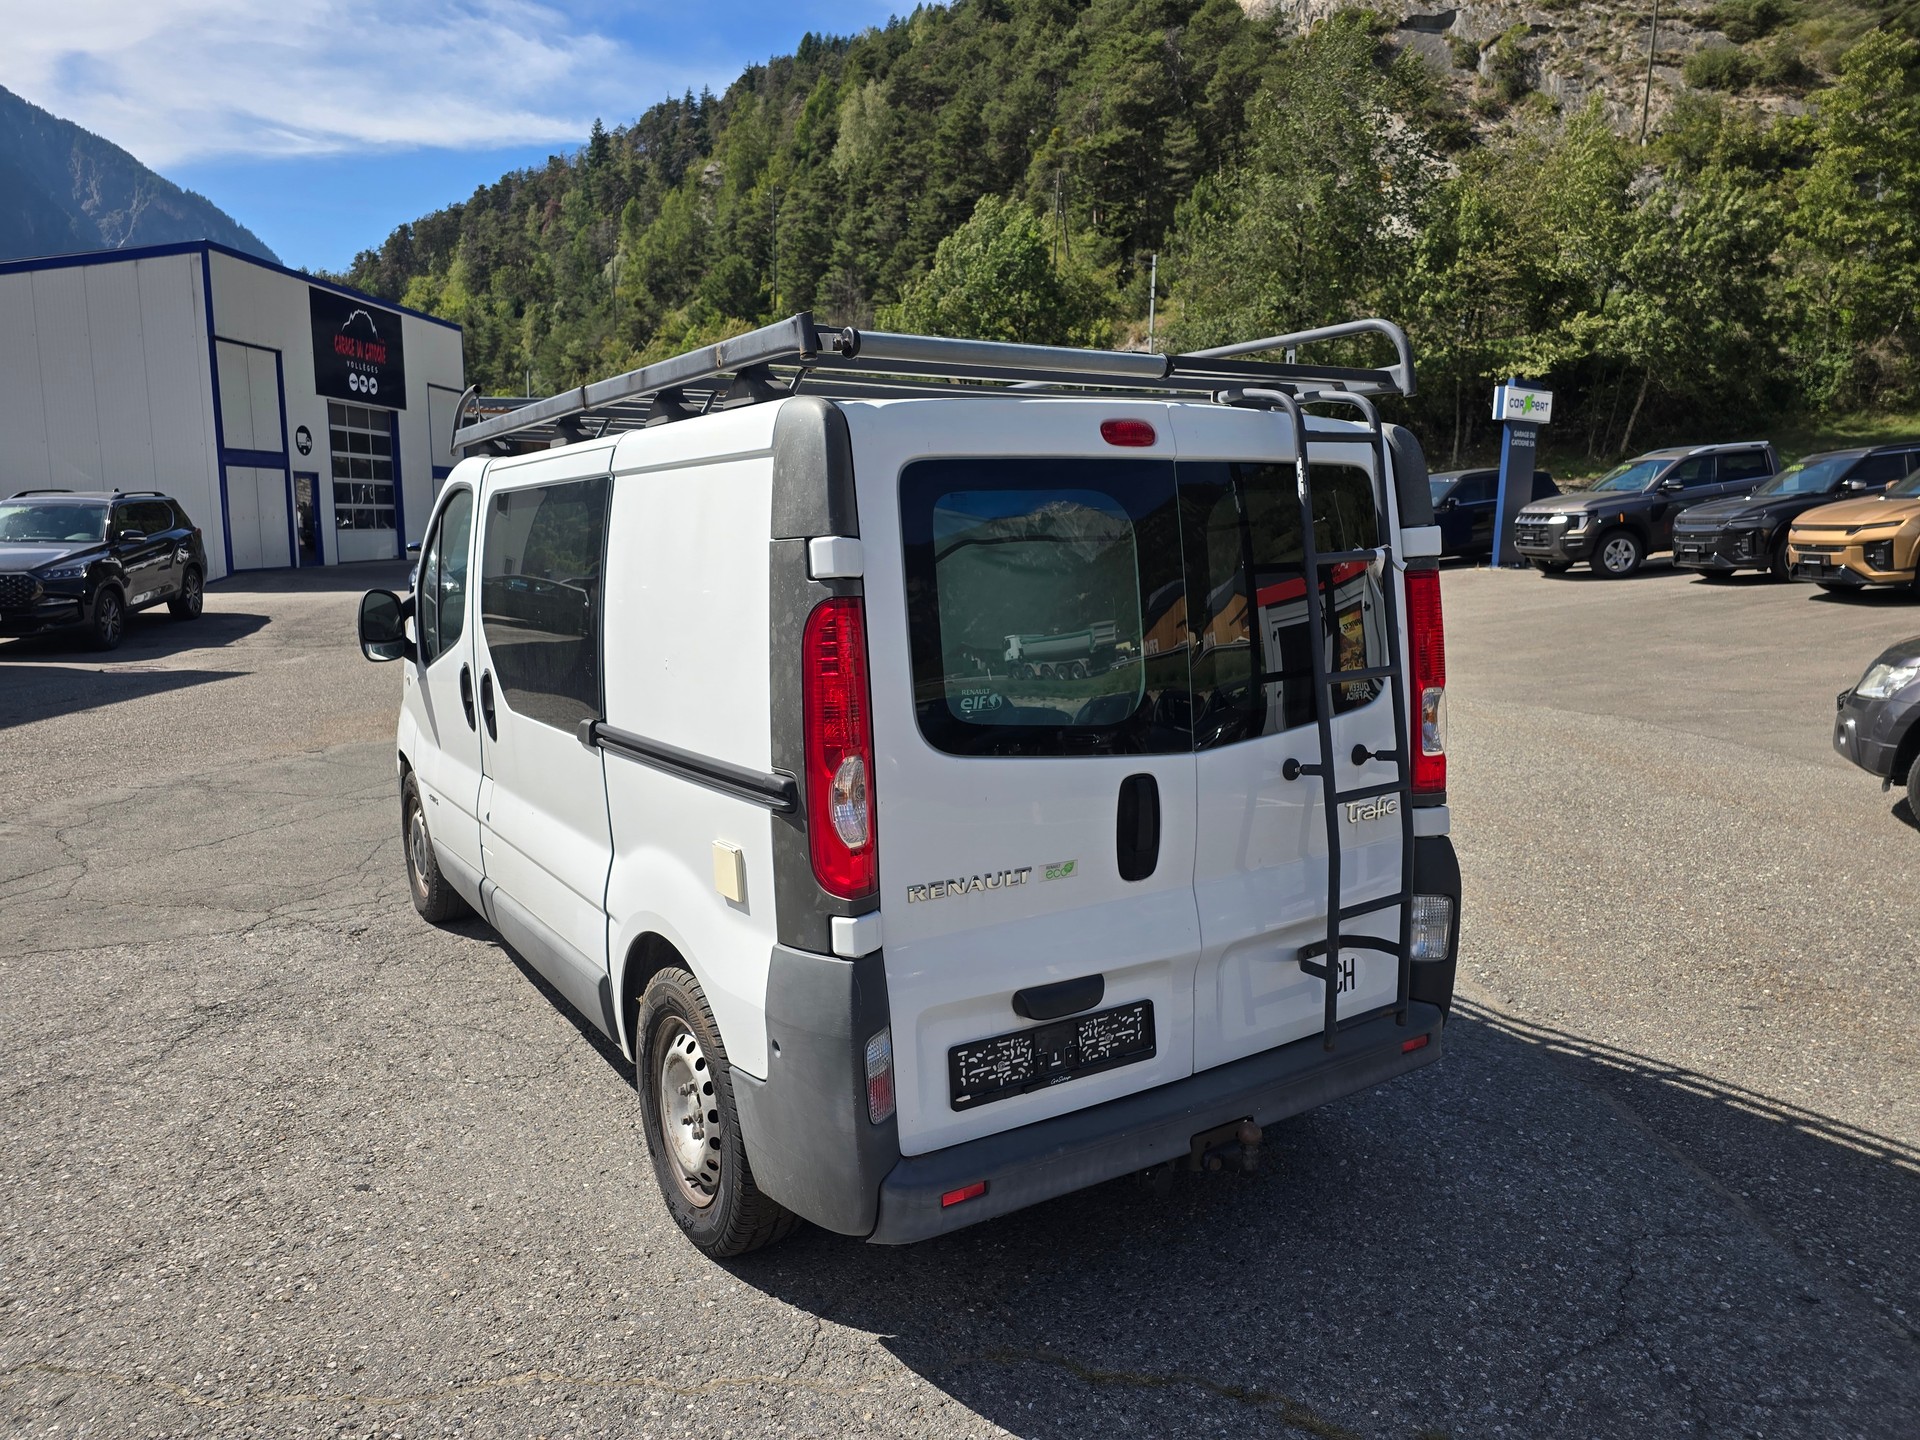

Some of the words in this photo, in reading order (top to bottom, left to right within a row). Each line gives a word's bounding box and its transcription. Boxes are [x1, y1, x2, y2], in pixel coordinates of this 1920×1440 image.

[1513, 430, 1530, 439] GARAGE
[961, 688, 991, 696] RENAULT
[960, 695, 988, 710] elf
[1345, 796, 1397, 824] Trafic
[1046, 865, 1069, 880] eco
[907, 866, 1032, 903] RENAULT
